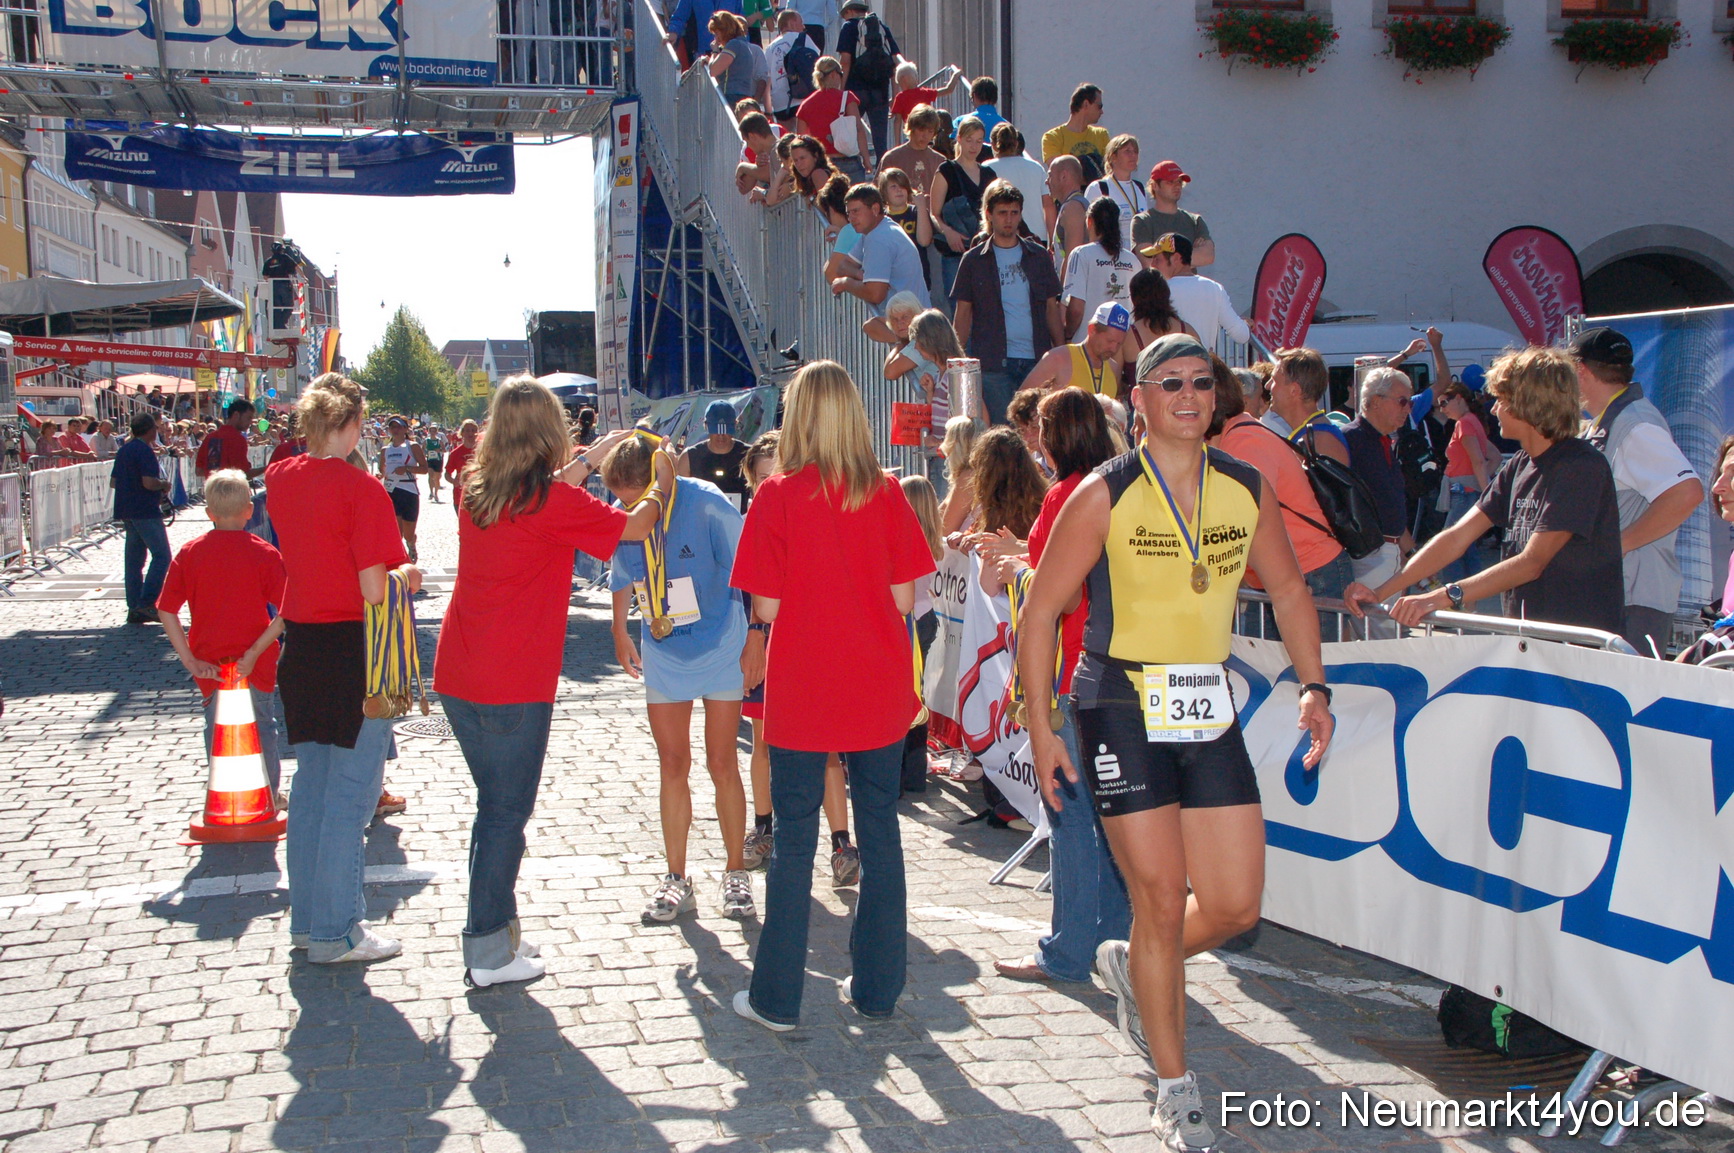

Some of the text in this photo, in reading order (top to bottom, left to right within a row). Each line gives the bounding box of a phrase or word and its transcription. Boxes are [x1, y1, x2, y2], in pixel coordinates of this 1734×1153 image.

[52, 0, 408, 50] BOCK
[240, 150, 355, 178] ZIEL
[1307, 275, 1322, 302] Radio
[25, 341, 57, 350] Service
[106, 346, 151, 357] Serviceline:
[1202, 524, 1227, 534] sport
[1202, 526, 1248, 546] SCHÖLL
[1136, 549, 1179, 558] Allersberg
[1207, 543, 1246, 566] Running-
[1217, 560, 1241, 577] Team
[639, 593, 646, 603] B
[1168, 673, 1220, 688] Benjamin
[1150, 694, 1160, 707] D
[1170, 698, 1215, 721] 342
